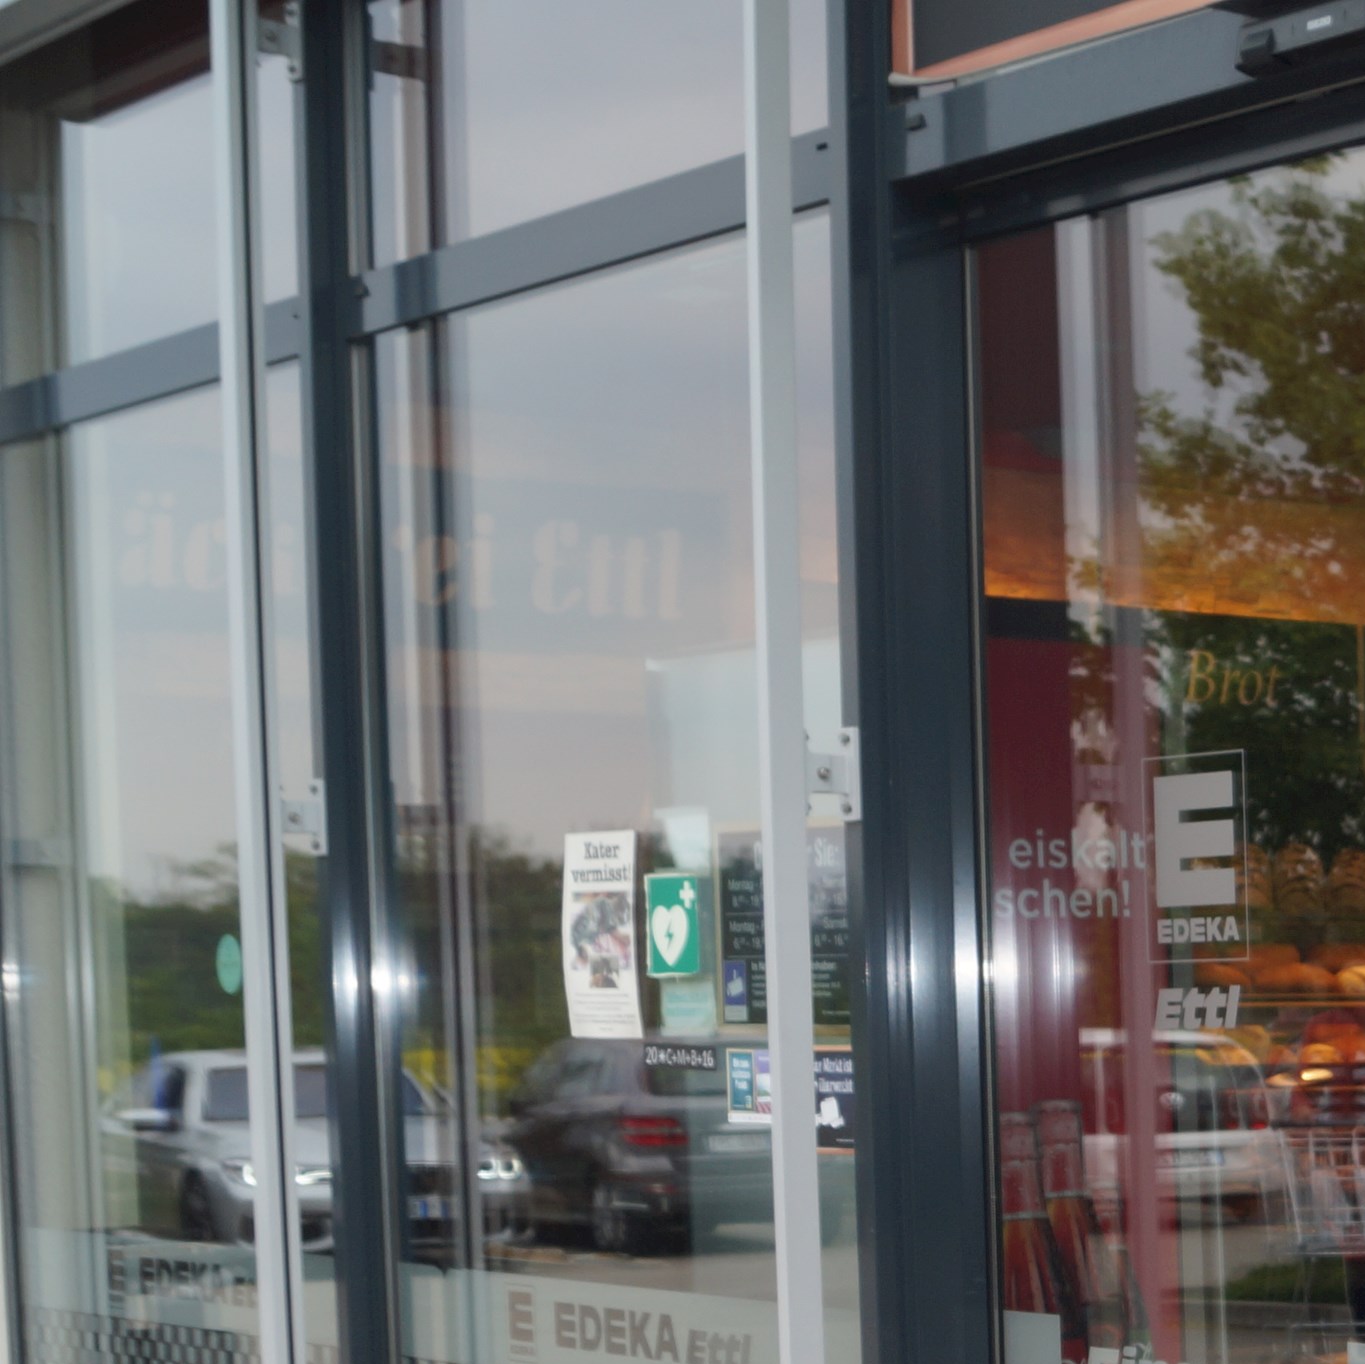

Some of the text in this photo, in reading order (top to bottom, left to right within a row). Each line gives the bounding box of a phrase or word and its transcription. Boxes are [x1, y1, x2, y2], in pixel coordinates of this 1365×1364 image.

[1187, 648, 1282, 706] Brot
[584, 841, 620, 860] Kater
[1008, 828, 1147, 870] eiskalt
[1156, 915, 1240, 943] EDEKA
[1154, 985, 1241, 1030] Ettl
[554, 1302, 680, 1363] EDEKA
